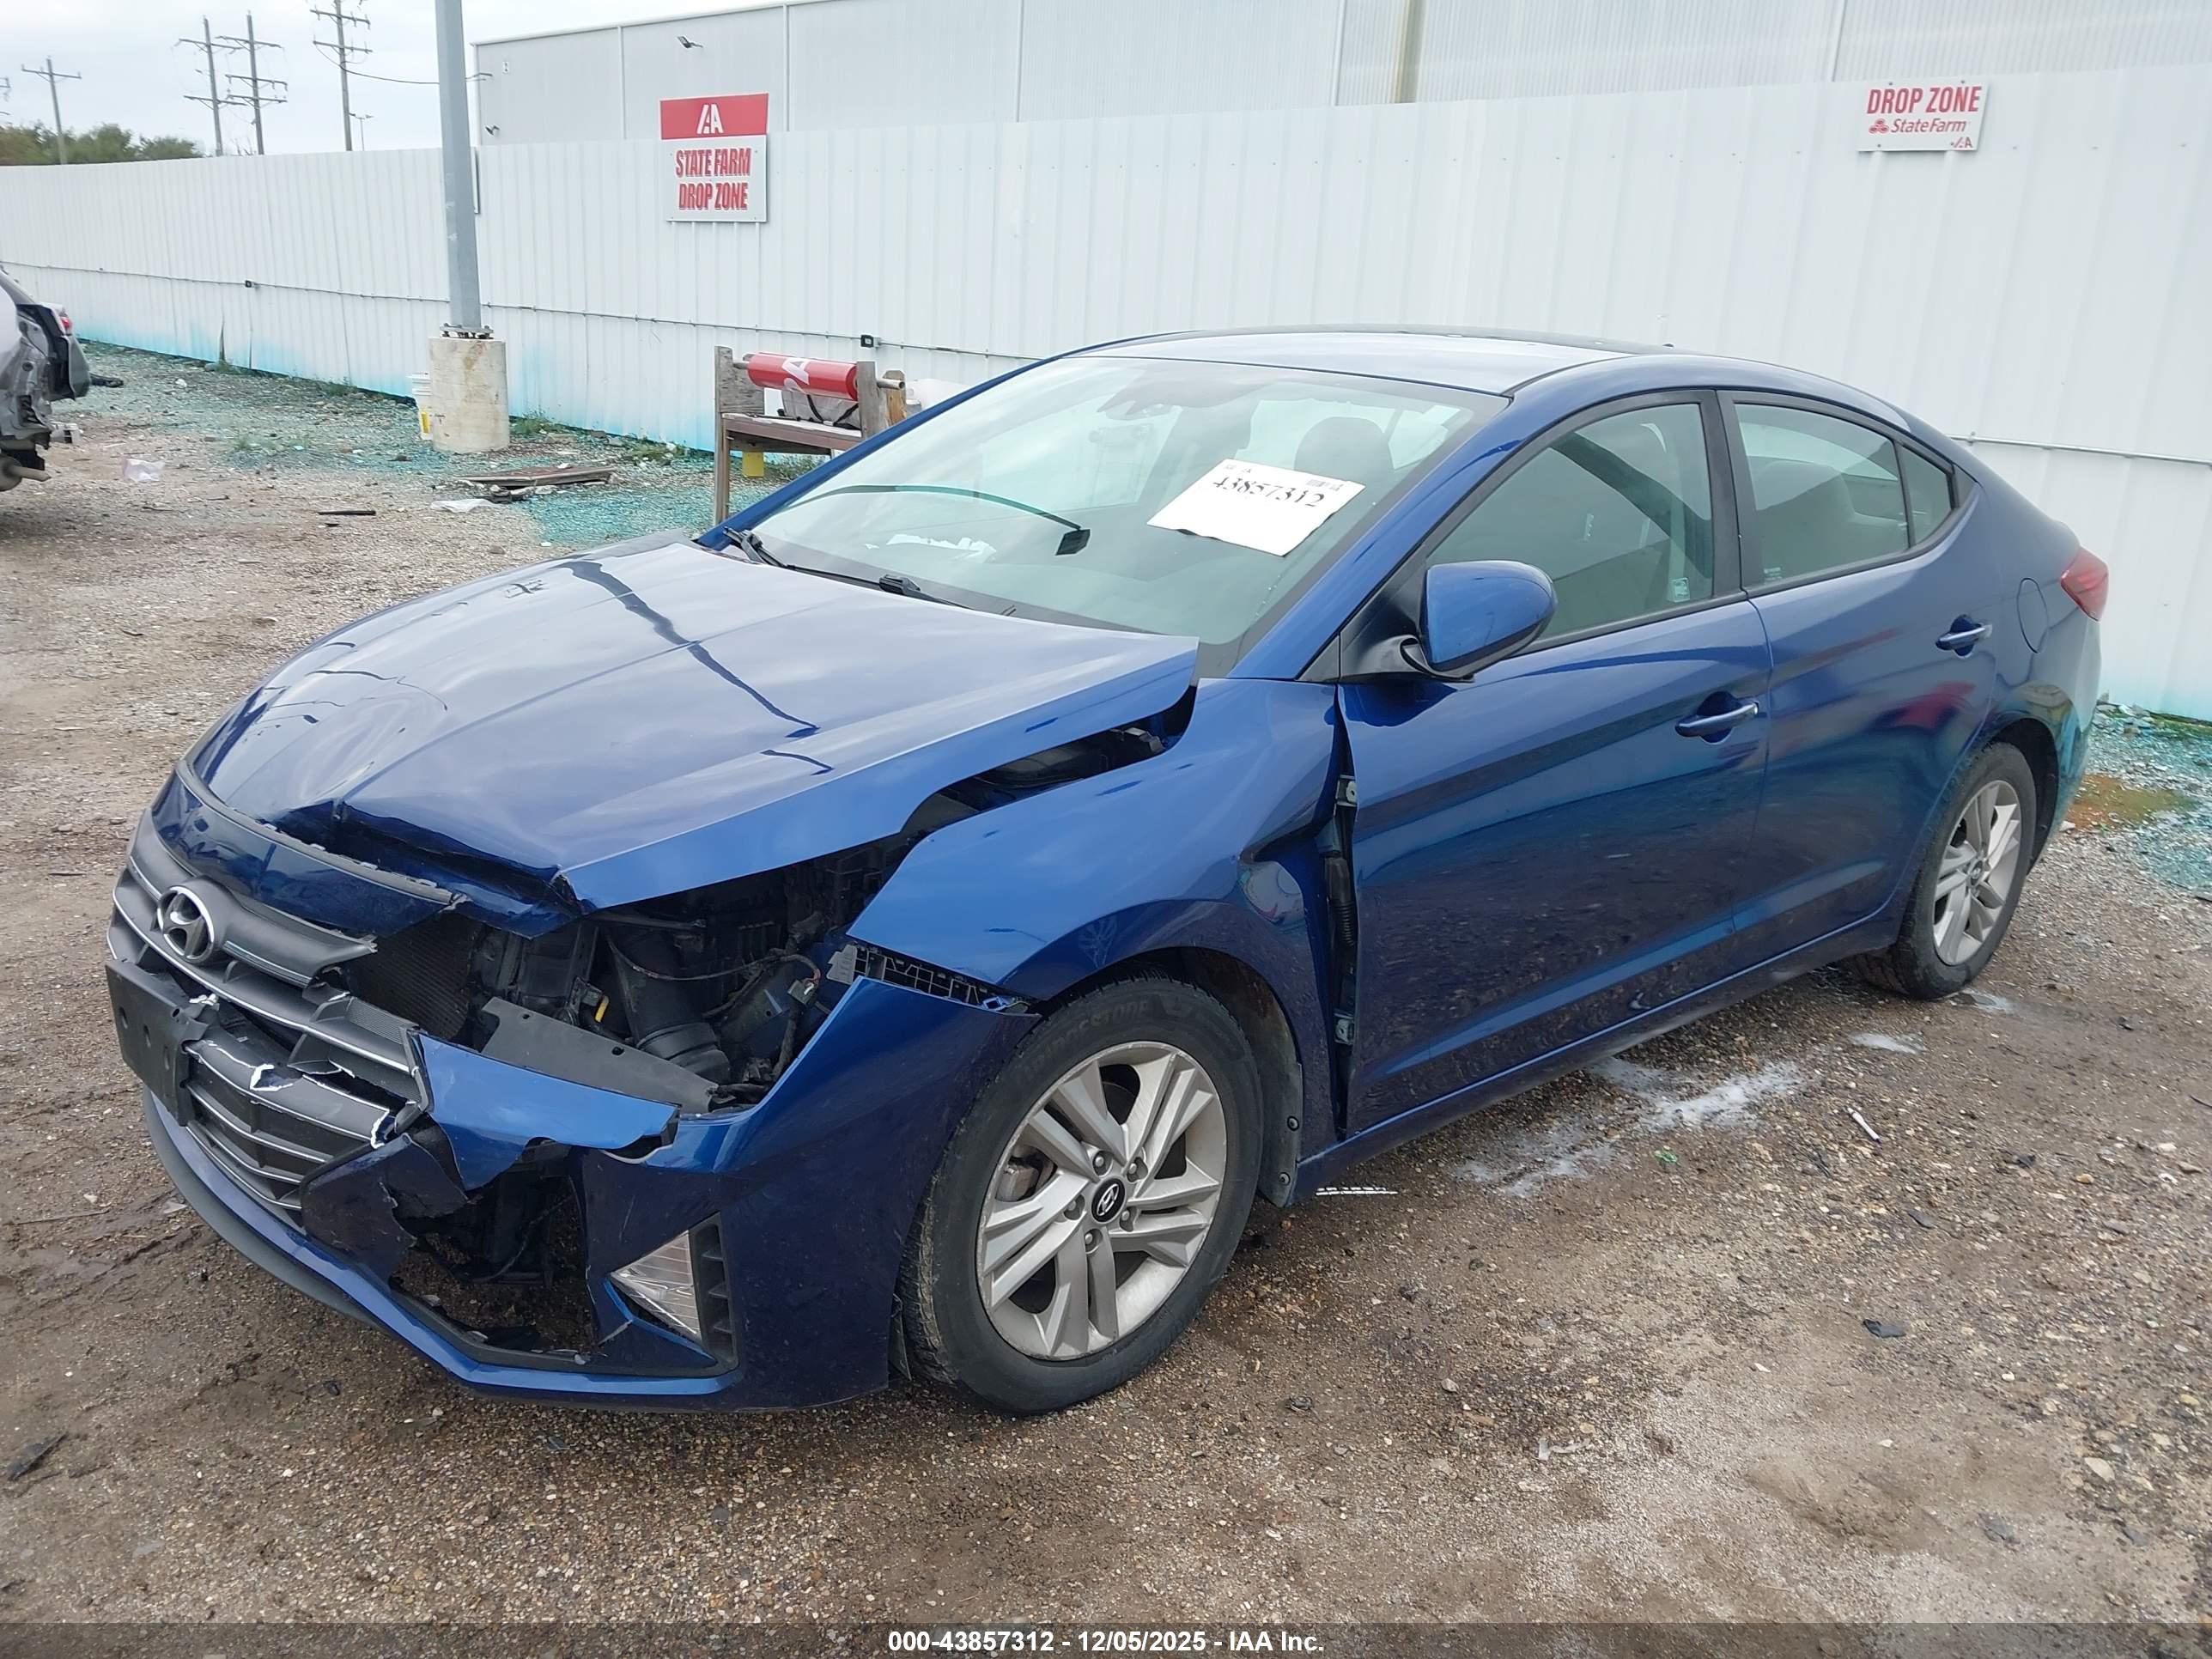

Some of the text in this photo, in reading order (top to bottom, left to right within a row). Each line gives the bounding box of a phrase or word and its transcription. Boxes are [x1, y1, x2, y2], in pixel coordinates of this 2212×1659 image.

[1867, 86, 1982, 114] DROP ZONE
[676, 147, 752, 178] STATE FARM
[678, 182, 749, 210] DROP ZONE
[1212, 476, 1325, 507] 43857312
